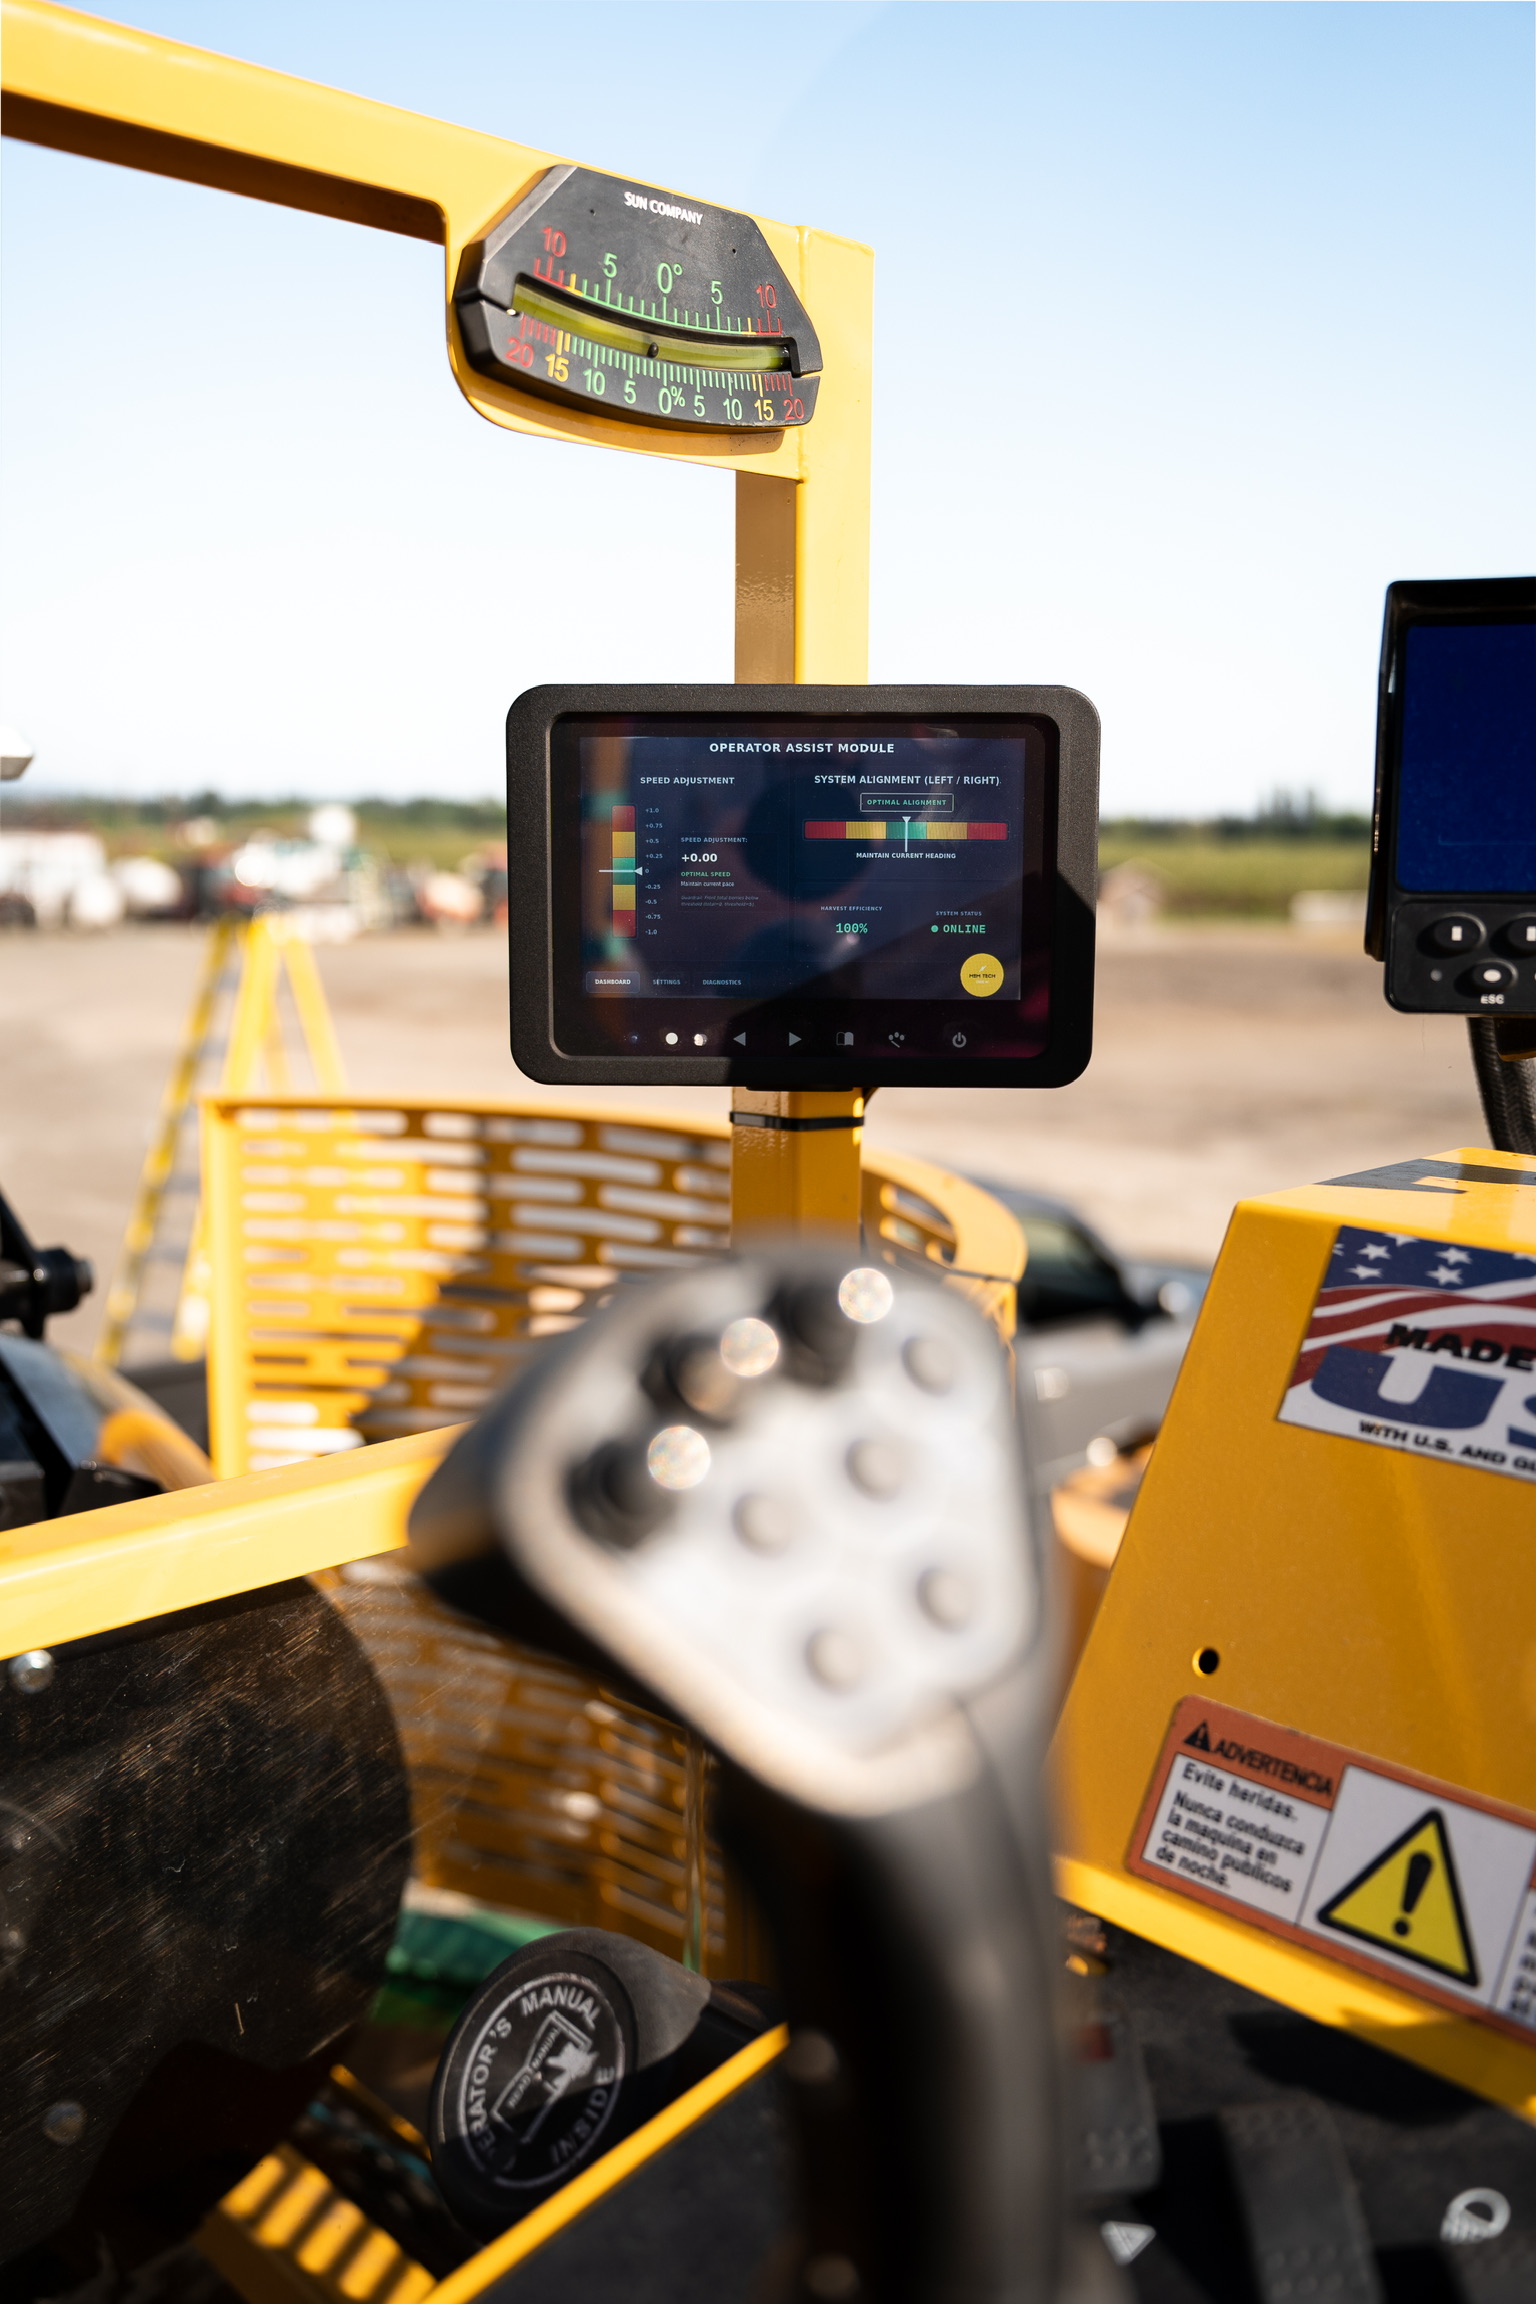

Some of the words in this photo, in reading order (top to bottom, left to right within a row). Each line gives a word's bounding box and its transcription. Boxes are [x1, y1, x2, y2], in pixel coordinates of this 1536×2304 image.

[624, 191, 648, 211] SUN
[649, 199, 703, 225] COMPANY
[540, 226, 567, 258] 10
[602, 252, 618, 278] 5
[710, 280, 723, 305] 5
[756, 284, 777, 309] 10
[505, 336, 534, 368] 20
[545, 353, 569, 382] 15
[583, 368, 606, 395] 10
[623, 380, 637, 404] 5
[658, 385, 686, 414] 0%
[693, 395, 706, 417] 5
[722, 398, 743, 420] 10
[754, 399, 774, 421] 15
[784, 398, 805, 420] 20
[709, 742, 781, 753] OPERATOR
[786, 743, 834, 753] ASSIST
[838, 743, 894, 754] MODULE
[640, 776, 670, 784] SPEED
[673, 776, 735, 786] ADJUSTMENT
[814, 774, 856, 784] SYSTEM
[860, 774, 921, 784] ALIGNMENT
[924, 775, 954, 786] (LEFT
[964, 776, 1000, 786] RIGHT)
[681, 853, 718, 863] +0.00
[835, 922, 868, 934] 100%
[942, 924, 986, 934] ONLINE
[1480, 994, 1505, 1005] ESC
[1385, 1323, 1535, 1373] MADE
[1359, 1419, 1408, 1443] WITH
[1413, 1430, 1453, 1452] U.S.
[1460, 1443, 1507, 1466] AND
[1212, 1739, 1333, 1796] ADVERTENCIA
[1182, 1762, 1225, 1791] Evite
[1228, 1780, 1297, 1821] heridas.
[1174, 1790, 1223, 1822] Nunca
[1226, 1814, 1306, 1855] conduzca
[1162, 1829, 1218, 1861] camino
[1167, 1808, 1182, 1827] la
[1257, 1848, 1278, 1864] en
[1156, 1845, 1175, 1863] de
[520, 1985, 601, 2030] MANUAL
[551, 2066, 615, 2164] INSIDE
